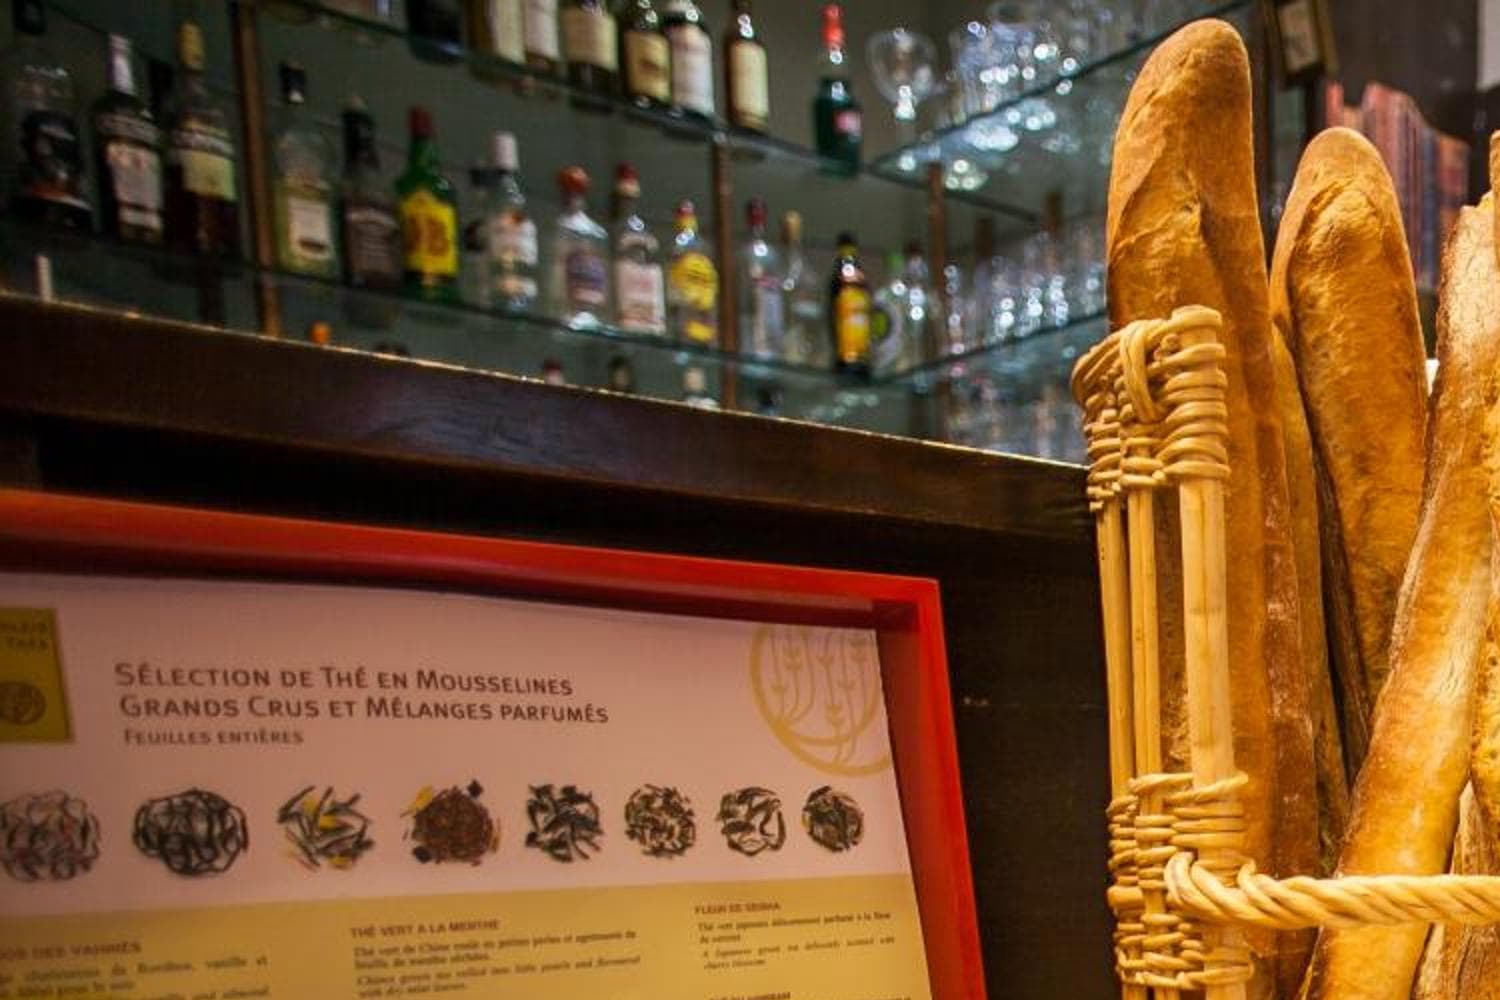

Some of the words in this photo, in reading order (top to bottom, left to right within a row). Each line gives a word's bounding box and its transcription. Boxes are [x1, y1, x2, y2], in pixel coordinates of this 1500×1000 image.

[115, 662, 270, 687] SÉLECTION
[281, 670, 312, 687] DE
[320, 666, 368, 689] THÉ
[378, 672, 407, 690] EN
[417, 670, 573, 696] MOUSSELINES
[120, 695, 239, 718] GRANDS
[248, 696, 319, 718] CRUS
[330, 700, 357, 718] ET
[367, 696, 493, 720] MÉLANGES
[501, 703, 608, 724] PARFUMÉS
[124, 728, 211, 745] FEUILLES
[218, 726, 303, 744] ENTIÈRES
[352, 926, 374, 938] THÉ
[381, 924, 412, 936] VERT
[430, 923, 446, 933] LA
[450, 920, 499, 931] MENTHE
